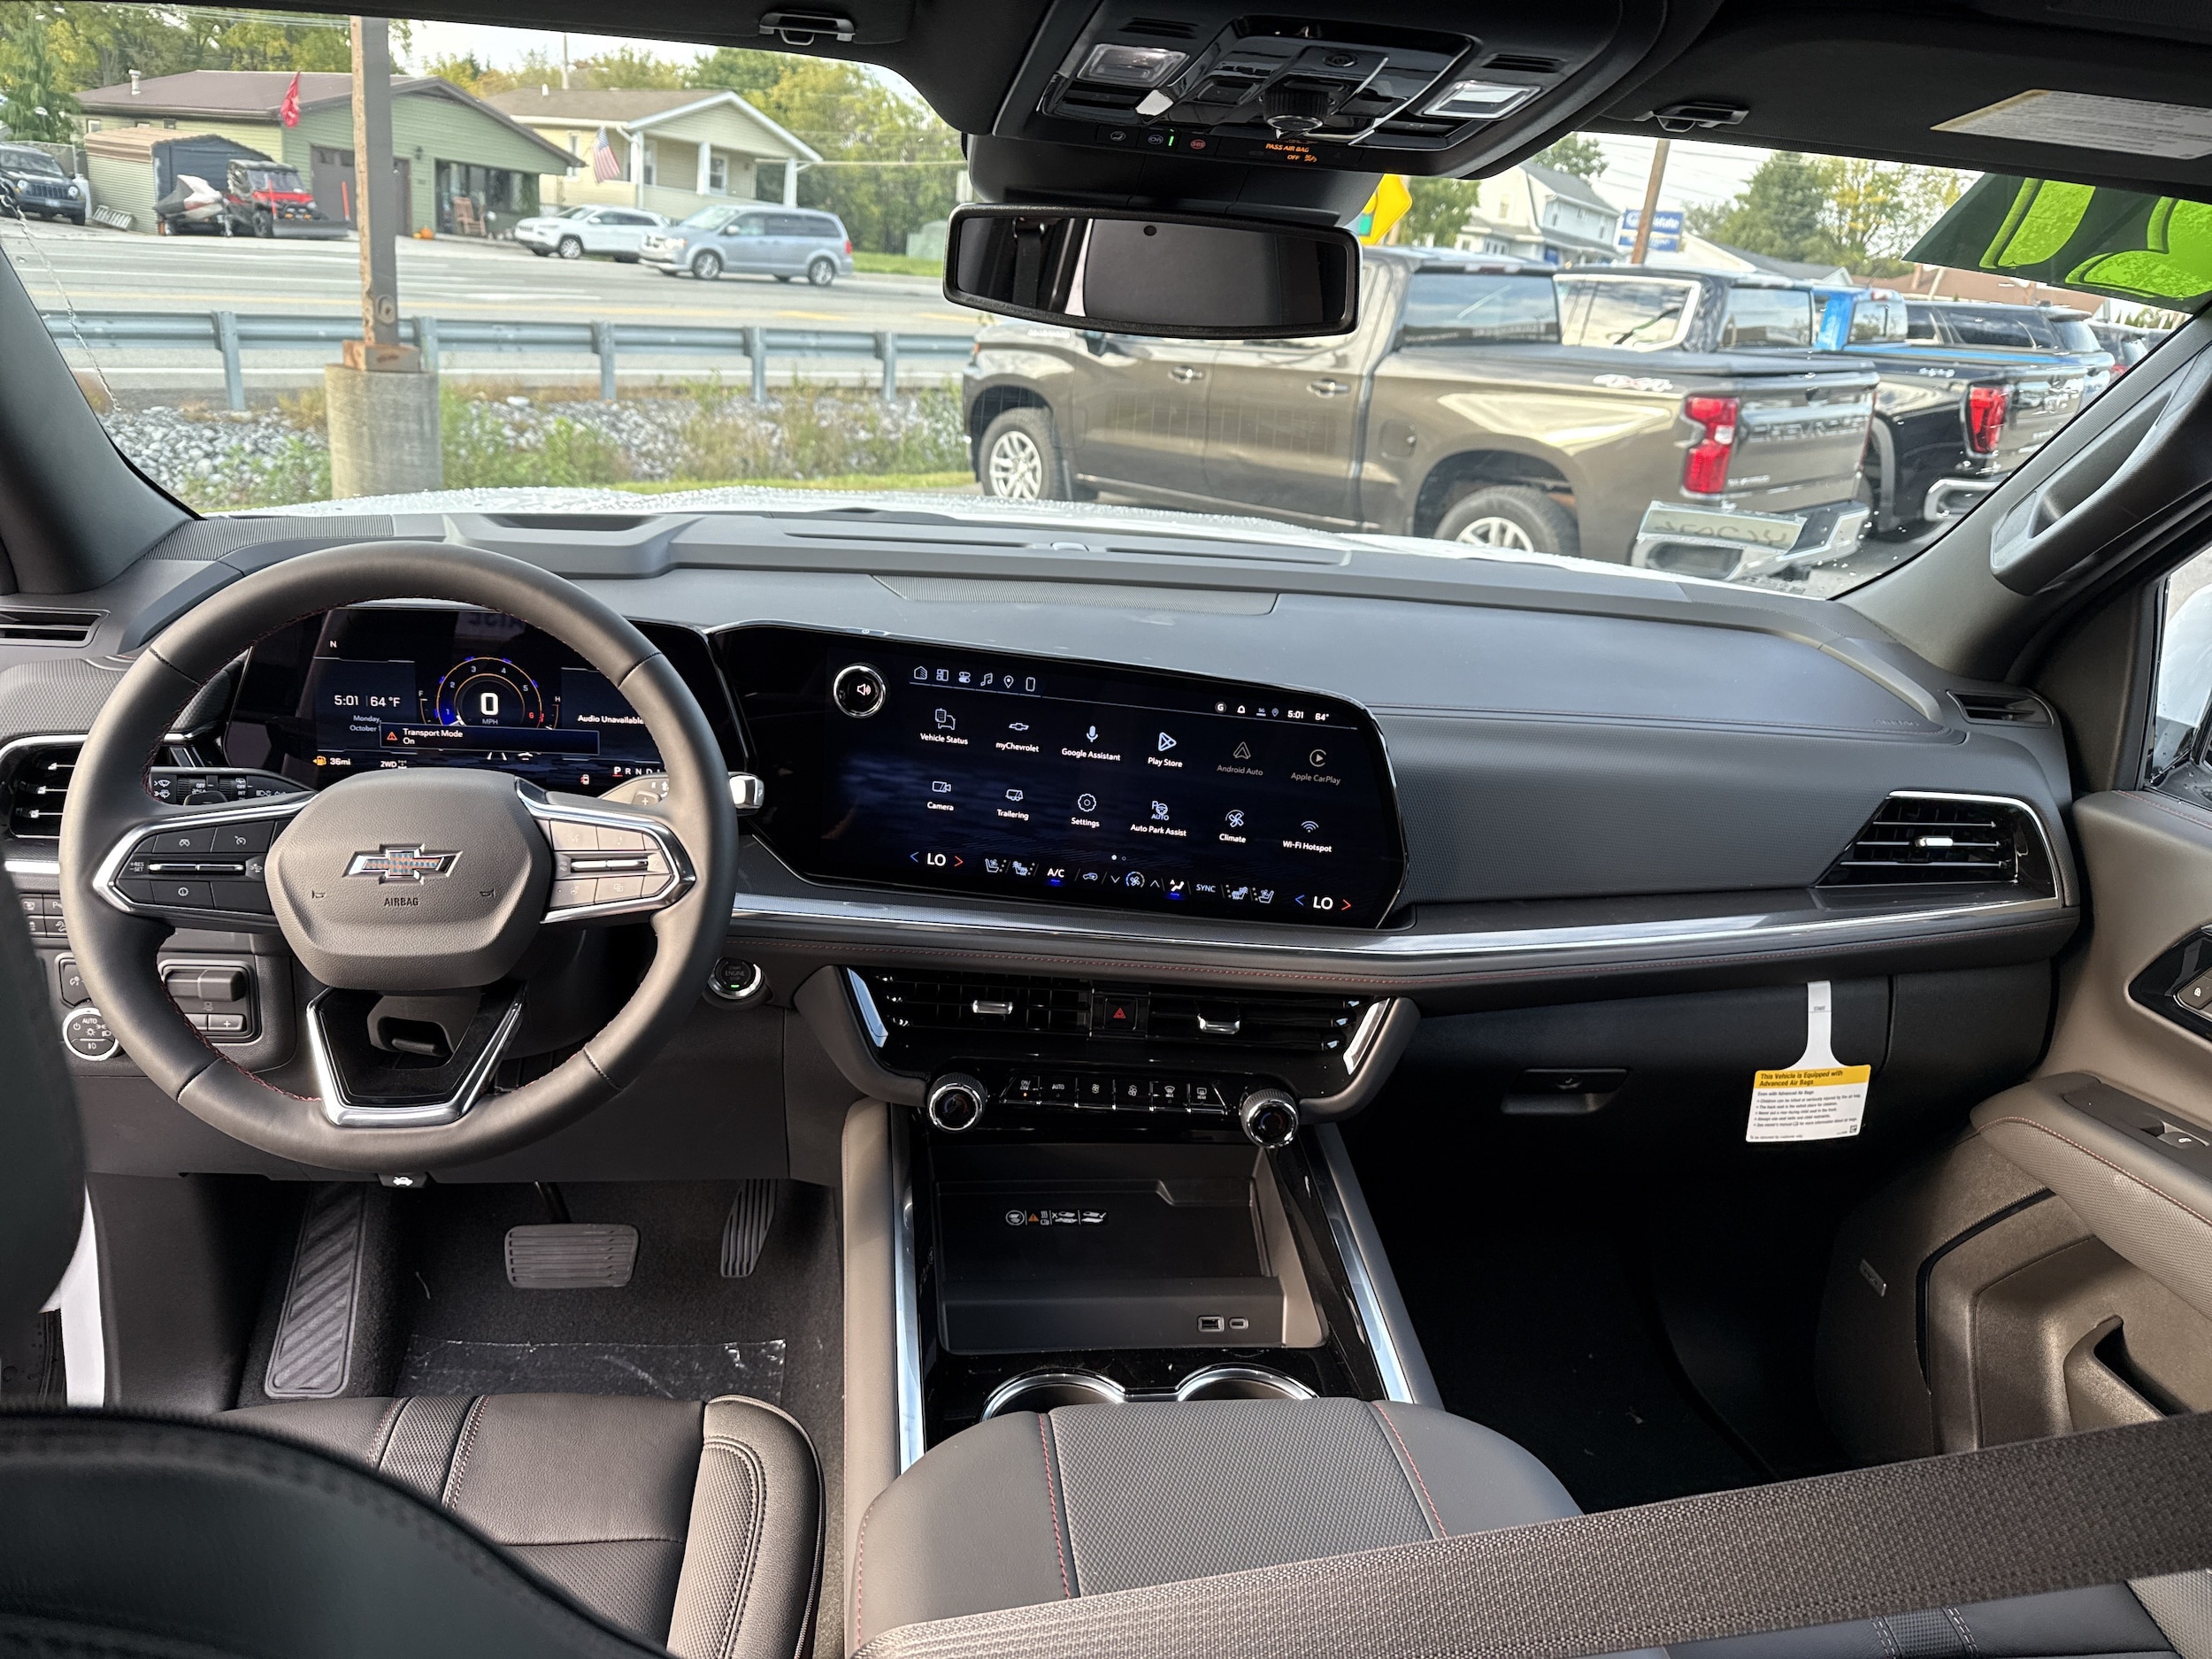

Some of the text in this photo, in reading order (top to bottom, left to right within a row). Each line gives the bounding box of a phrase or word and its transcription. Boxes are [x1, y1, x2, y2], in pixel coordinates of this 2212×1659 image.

[334, 695, 359, 706] 5:01
[370, 696, 386, 707] 64
[480, 692, 499, 716] 0
[353, 715, 382, 724] Monday,
[577, 714, 644, 725] Audio Unavailable
[1287, 710, 1304, 719] 5:01
[403, 728, 440, 738] Transport
[920, 733, 969, 745] Vehicle Status
[995, 741, 1040, 752] myChevrolet
[1061, 748, 1121, 761] Google Assistant
[329, 757, 351, 766] 36mi
[1148, 757, 1183, 768] Play Store
[613, 766, 621, 775] P
[1217, 764, 1263, 776] Android Auto
[1290, 772, 1341, 786] Apple CarPlay
[926, 801, 955, 811] Camera
[996, 809, 1030, 821] Trailering
[1071, 817, 1100, 828] Settings
[1130, 824, 1187, 836] Auto Park Assist
[1218, 833, 1247, 843] Climate
[1283, 840, 1333, 853] Wi-Fi Hotspot
[927, 852, 947, 867] LO
[1047, 868, 1065, 879] A/C
[1195, 883, 1217, 894] SYNC
[384, 897, 419, 906] AIRBAG
[1312, 895, 1334, 910] LO
